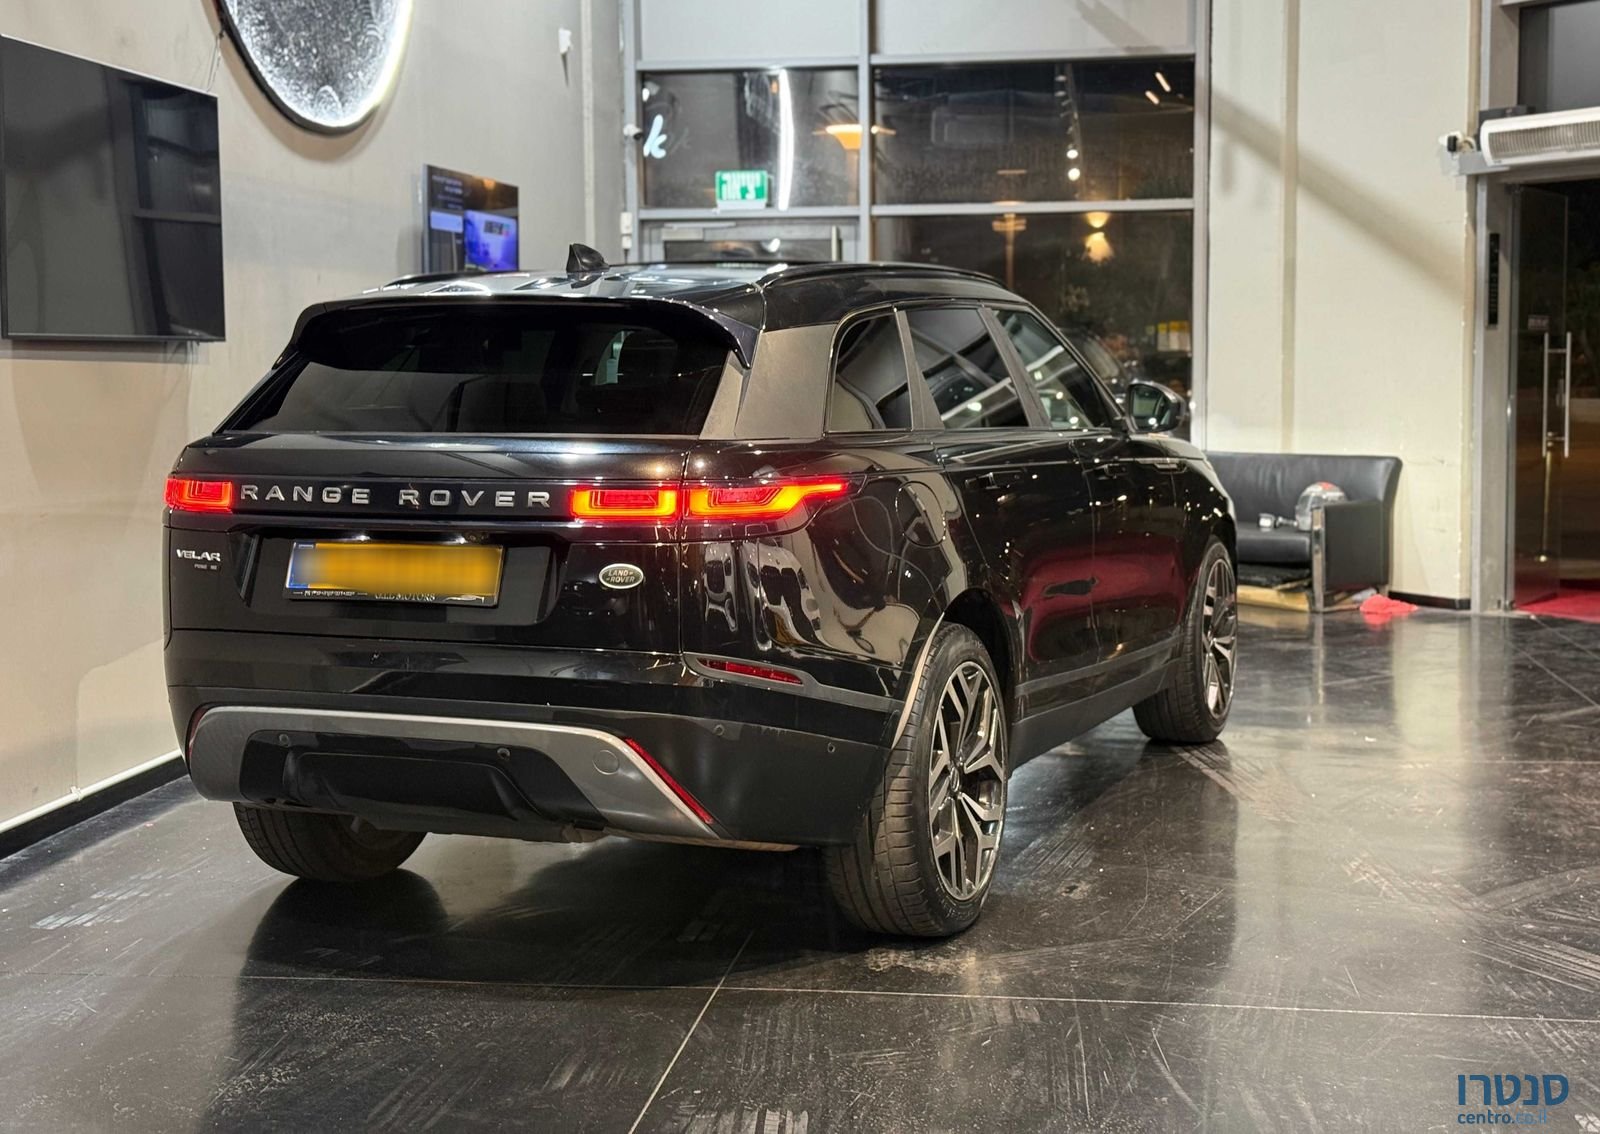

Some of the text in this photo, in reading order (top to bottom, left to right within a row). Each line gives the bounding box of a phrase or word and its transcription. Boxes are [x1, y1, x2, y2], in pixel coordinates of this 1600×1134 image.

[240, 485, 550, 508] RANGE ROVER
[176, 549, 221, 562] VELAR
